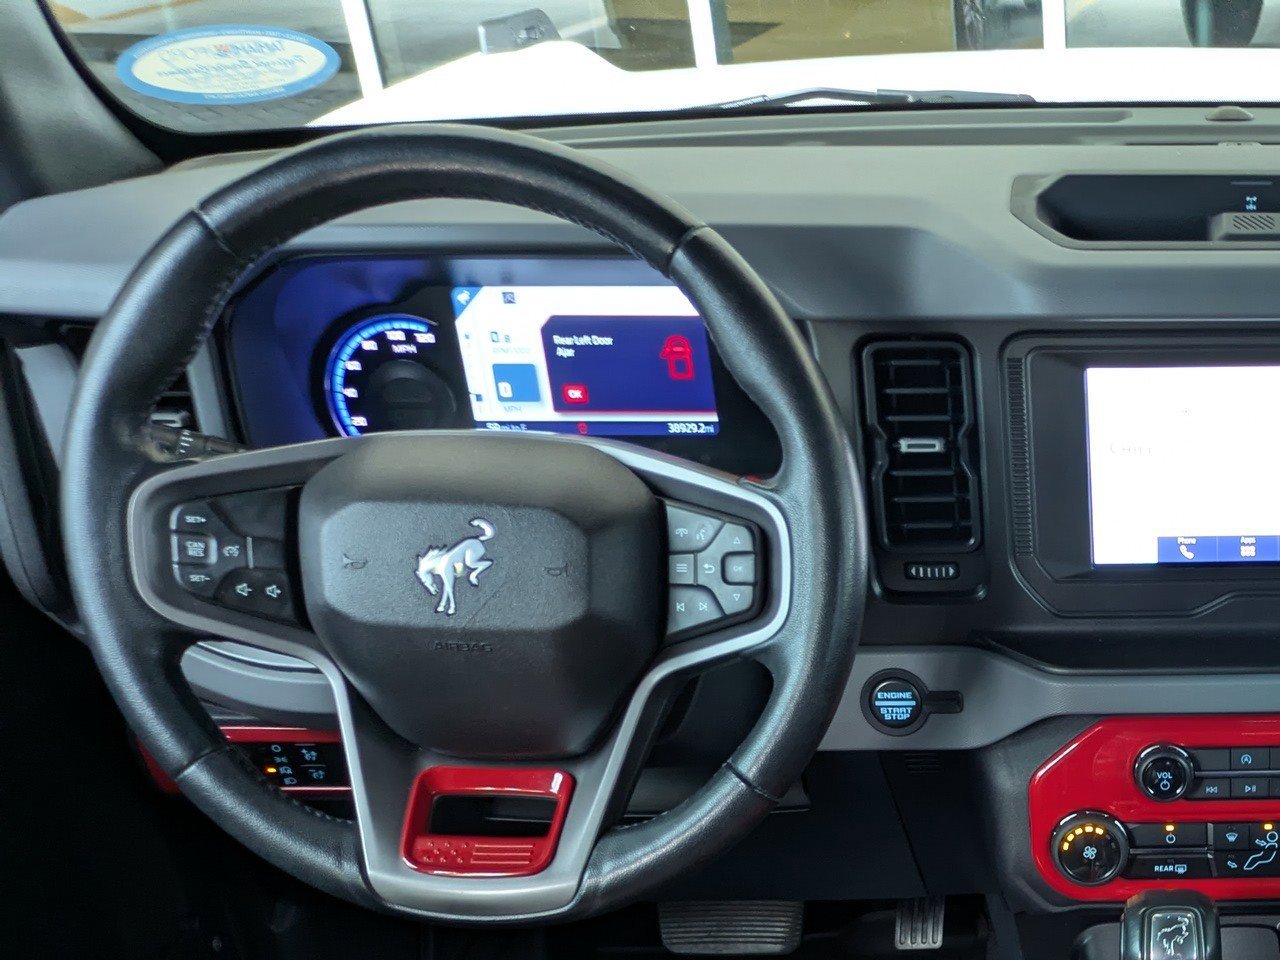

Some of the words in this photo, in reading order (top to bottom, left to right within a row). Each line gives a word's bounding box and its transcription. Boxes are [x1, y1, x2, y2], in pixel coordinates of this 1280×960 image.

[567, 389, 583, 399] OK
[1177, 537, 1197, 545] Phone
[1240, 536, 1256, 544] Apps
[877, 691, 913, 699] ENGINE
[1156, 772, 1173, 780] VOL
[1154, 865, 1174, 873] REAR
